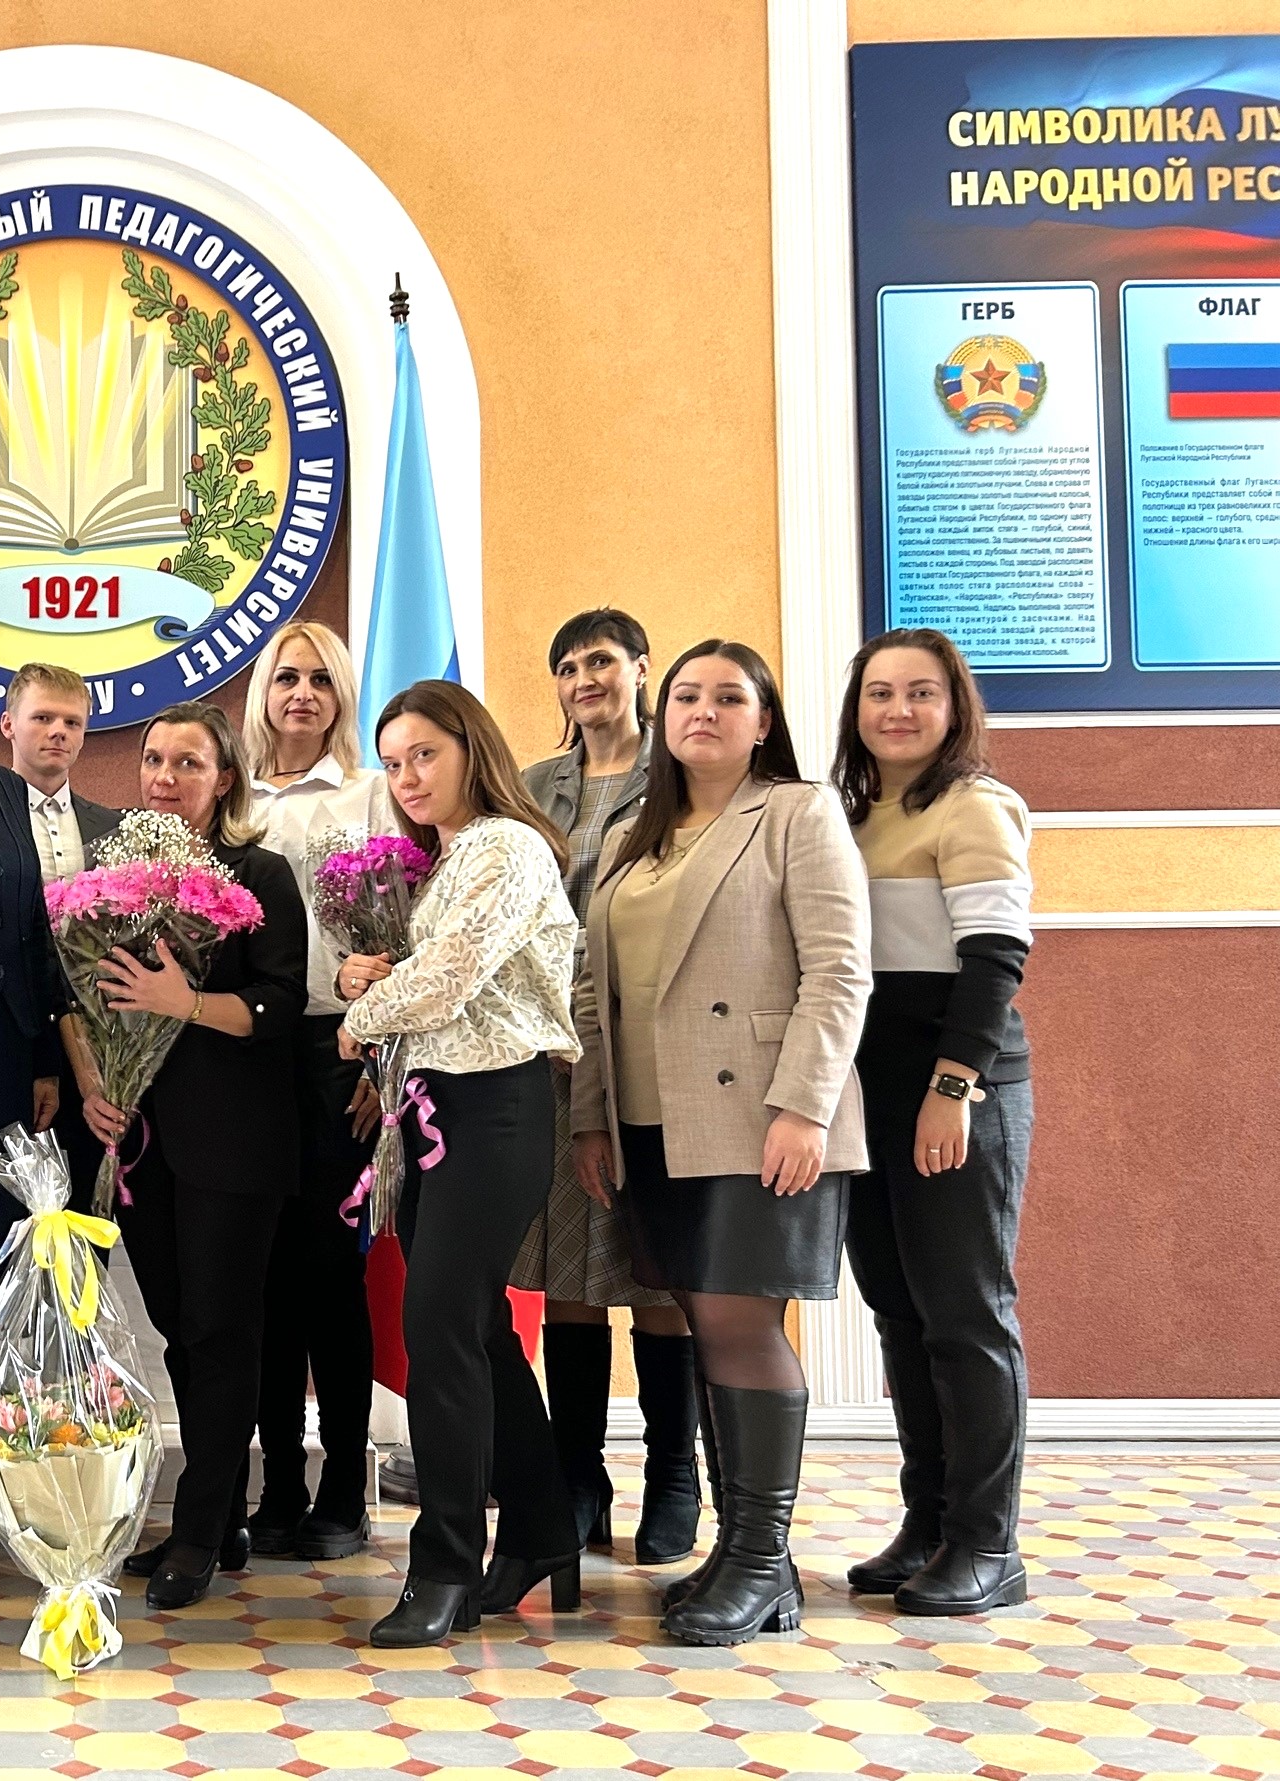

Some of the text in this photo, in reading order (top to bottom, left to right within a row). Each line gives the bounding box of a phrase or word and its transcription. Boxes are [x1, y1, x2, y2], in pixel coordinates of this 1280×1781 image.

[947, 106, 1226, 146] СИМВОЛИКА
[950, 157, 1194, 211] НАРОДНОЙ
[78, 194, 340, 432] ПЕДАГОГИЧЕСКИЙ
[961, 301, 1015, 321] ГЕРБ
[1198, 297, 1261, 316] ФЛАГ
[176, 456, 335, 688] УНИВЕРСИТЕТ
[22, 575, 120, 619] 1921
